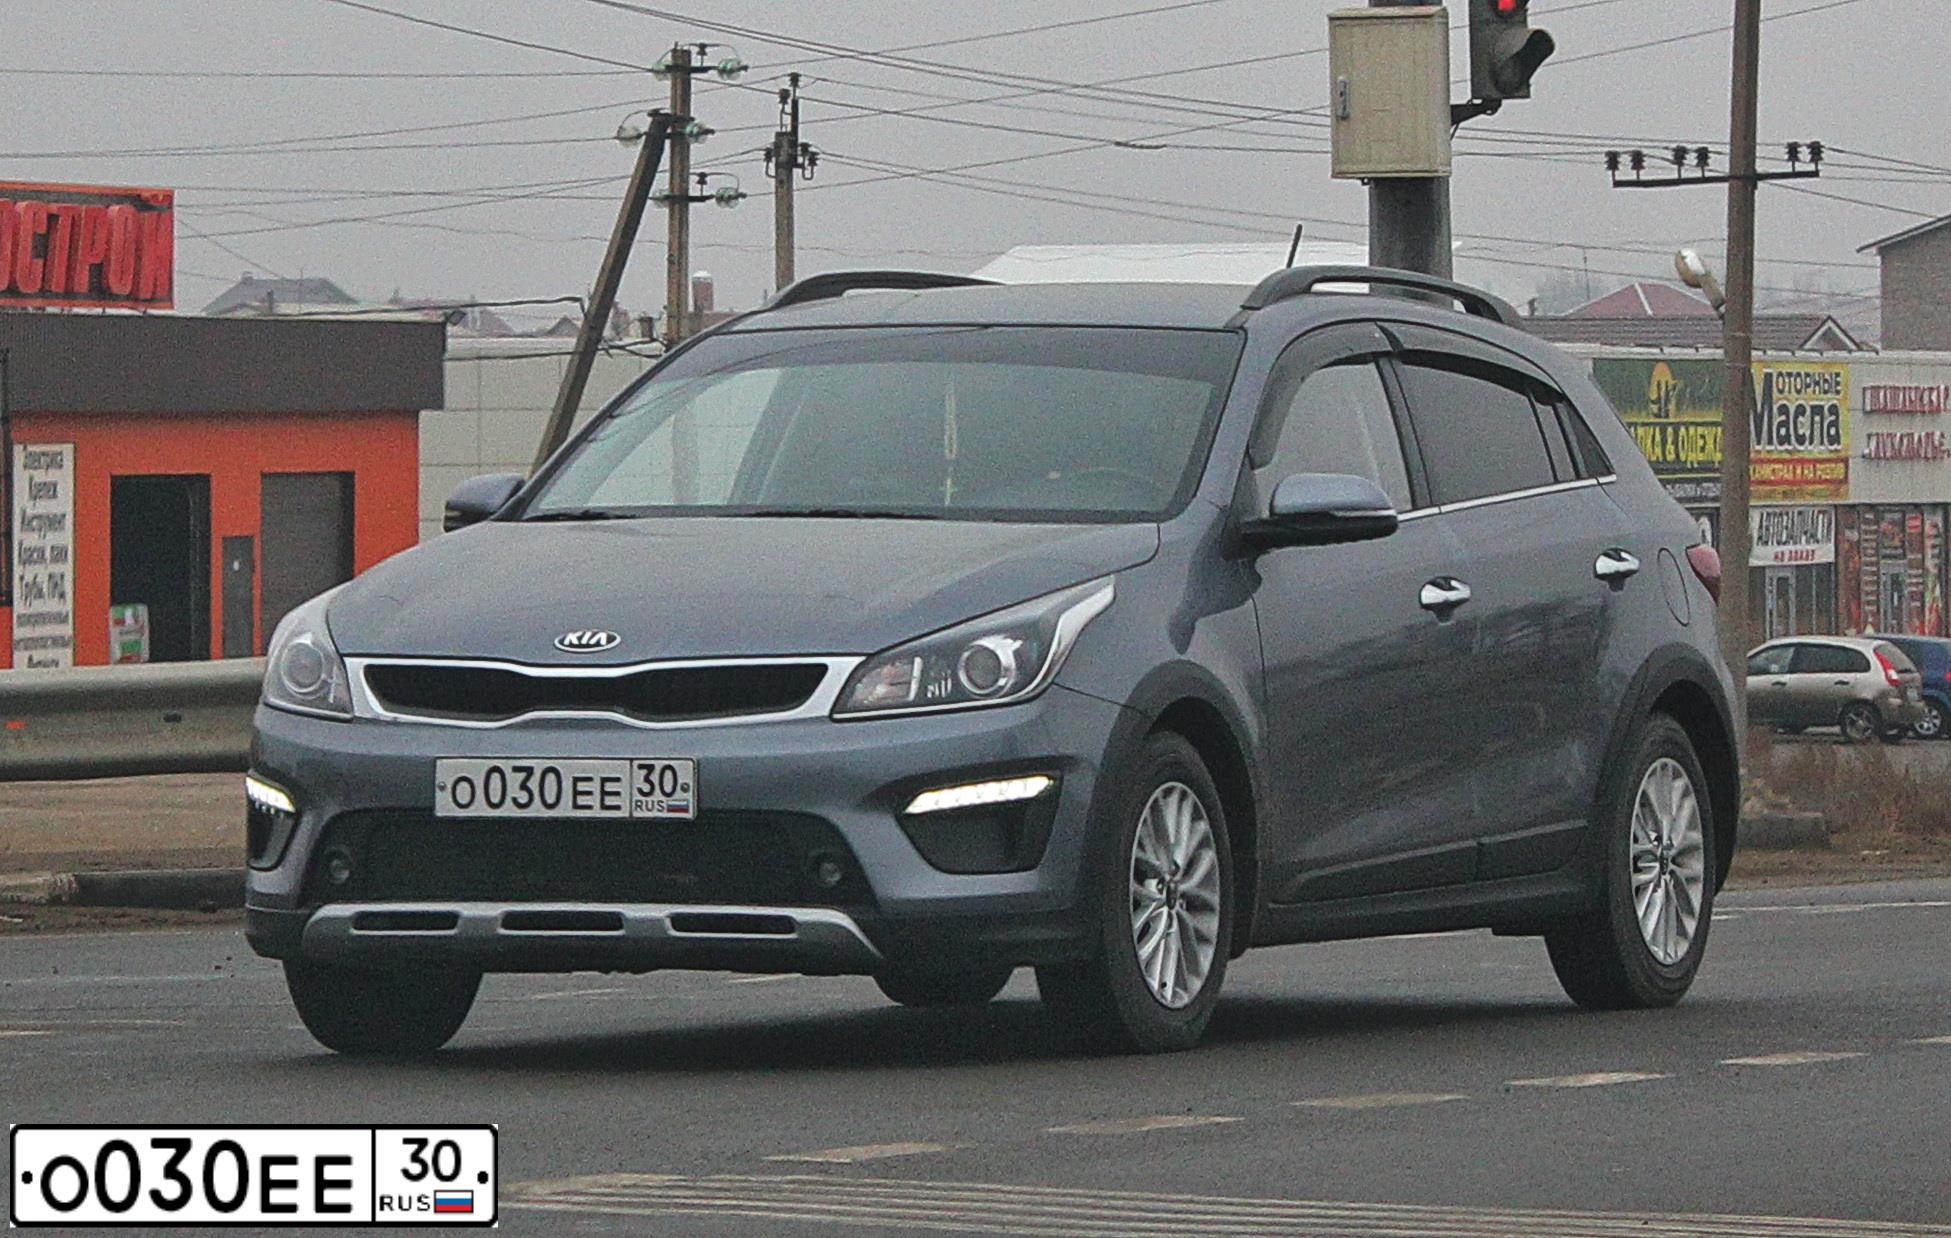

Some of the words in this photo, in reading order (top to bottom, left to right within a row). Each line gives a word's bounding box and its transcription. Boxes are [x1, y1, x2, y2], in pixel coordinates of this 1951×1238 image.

[563, 630, 608, 646] KIA
[636, 763, 679, 798] 30
[634, 799, 665, 813] RUS
